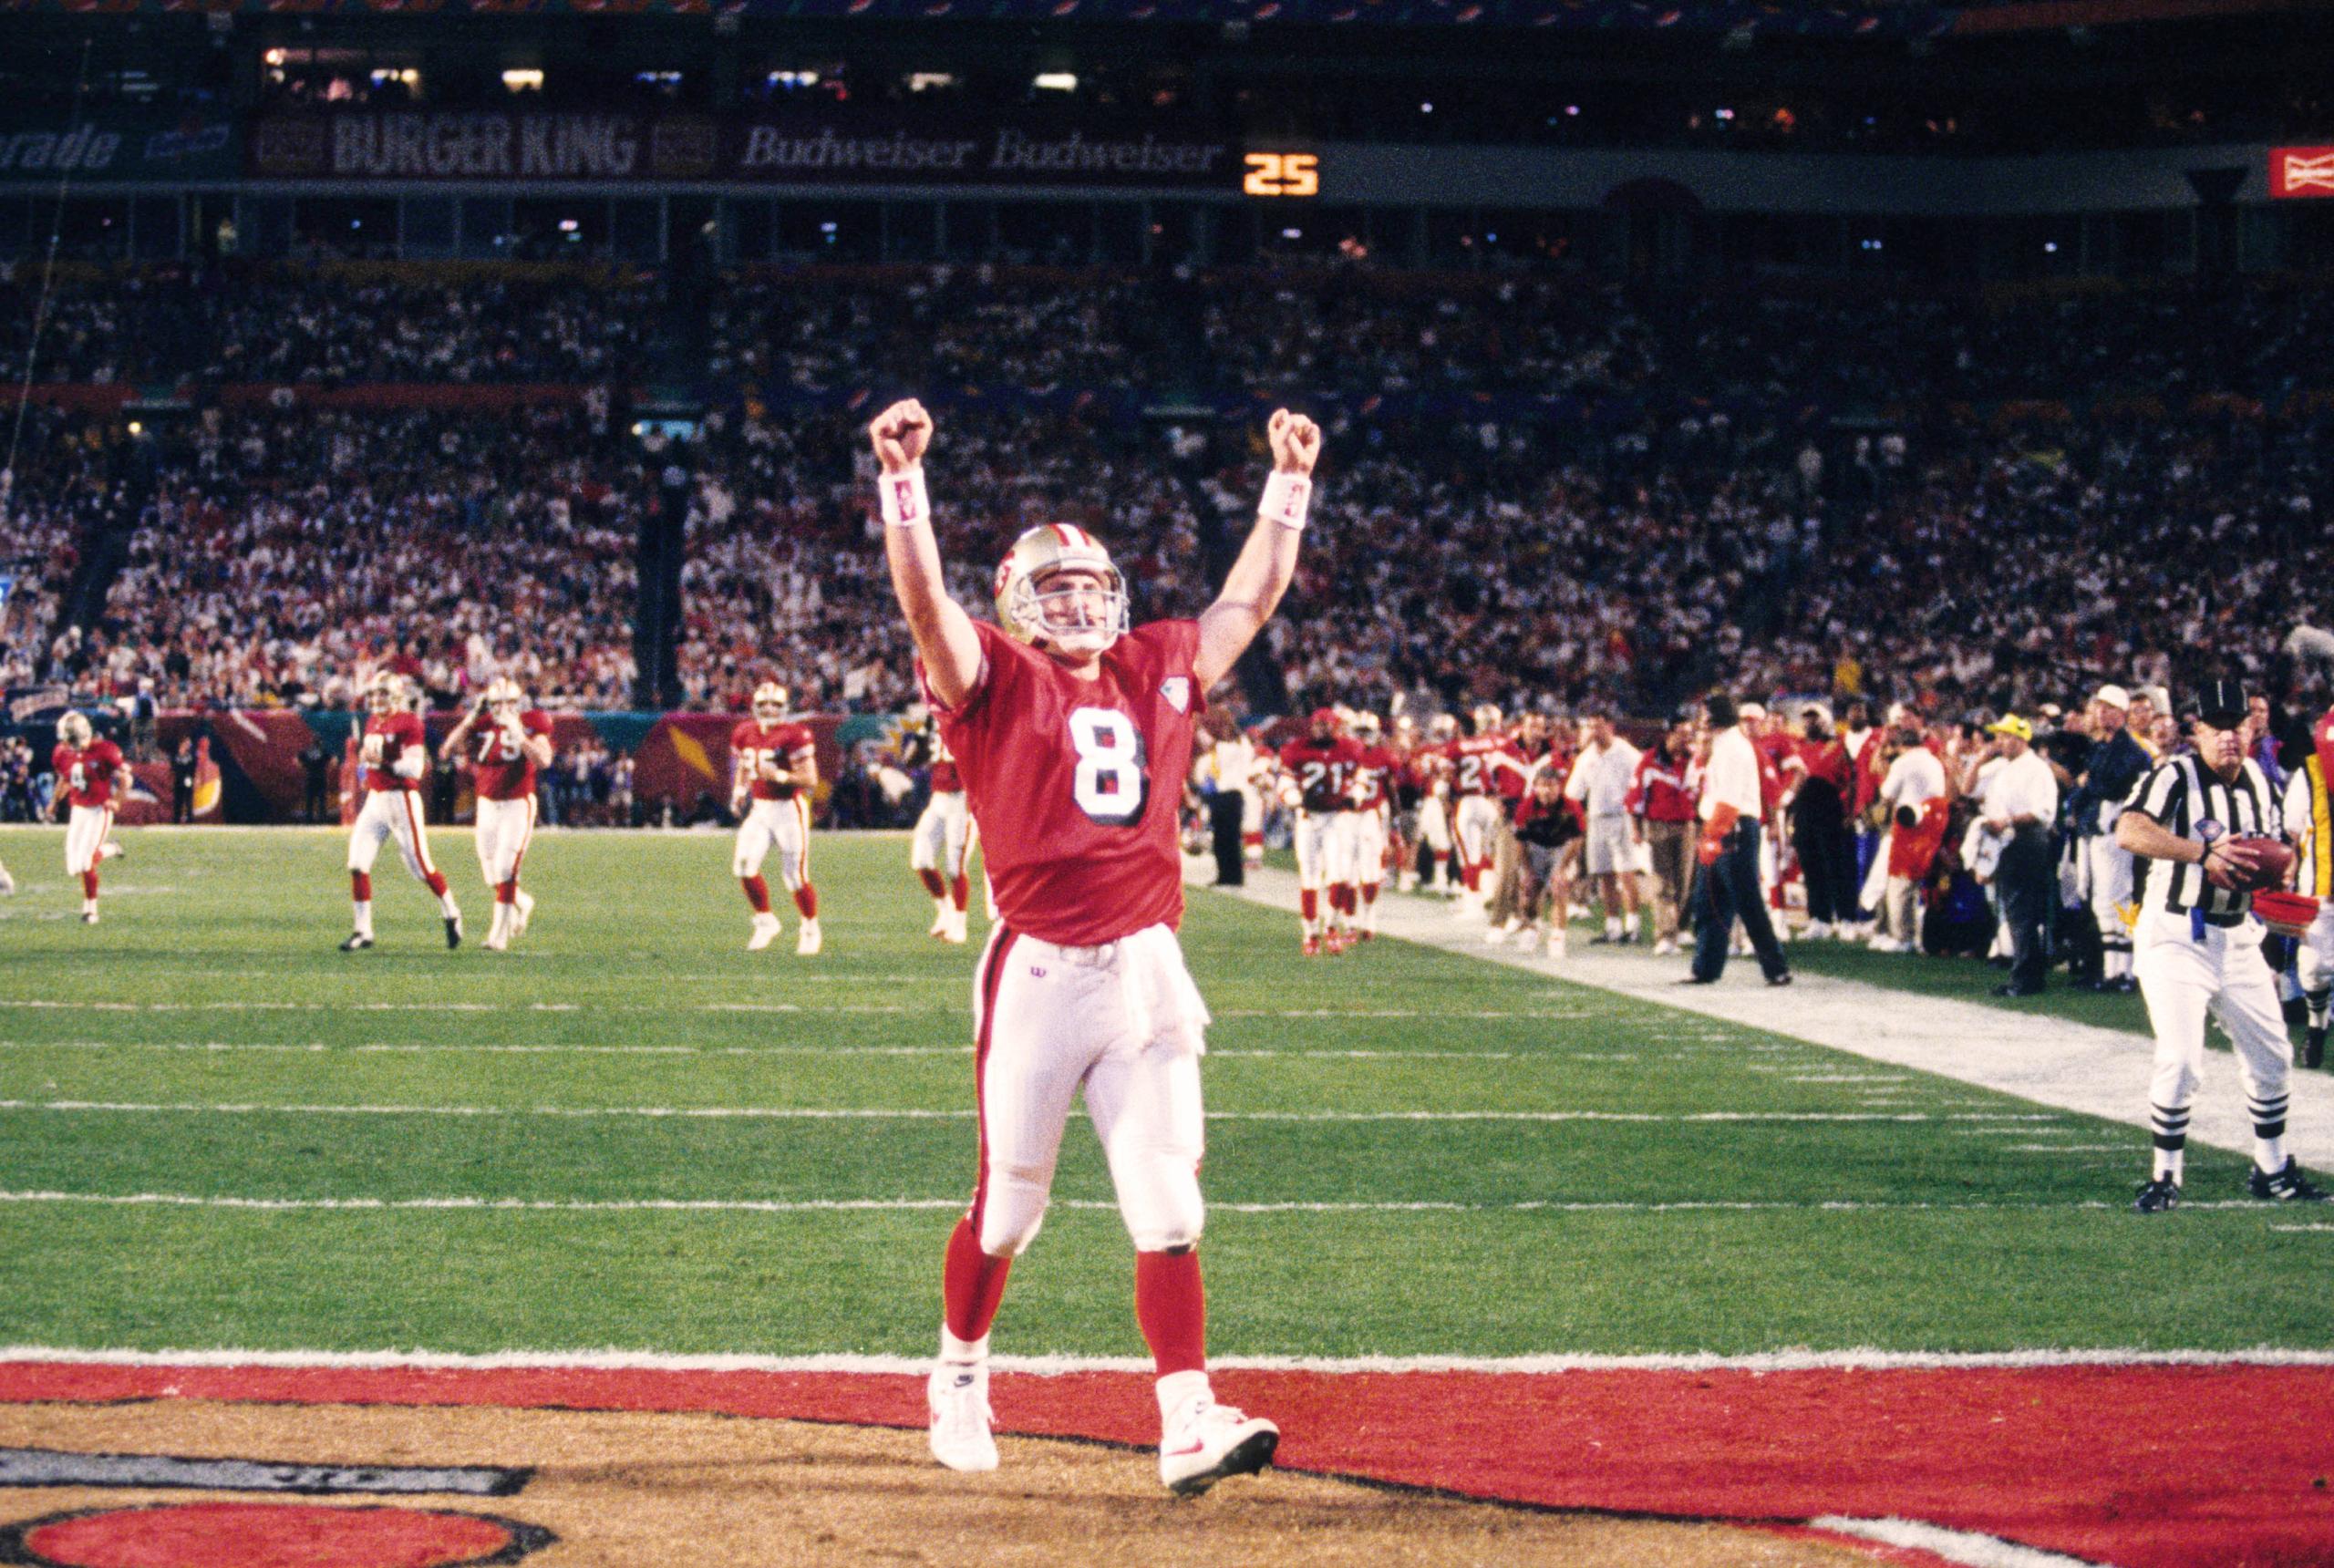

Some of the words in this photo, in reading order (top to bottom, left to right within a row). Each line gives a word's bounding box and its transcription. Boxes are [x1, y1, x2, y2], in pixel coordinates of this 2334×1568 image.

[0, 124, 120, 169] rade
[333, 114, 511, 173] BURGER
[521, 114, 636, 174] KING
[743, 127, 975, 169] Budweiser
[990, 129, 1223, 171] Budweiser
[1244, 152, 1318, 195] 25
[1069, 707, 1145, 820] 8
[1301, 760, 1343, 795] 21
